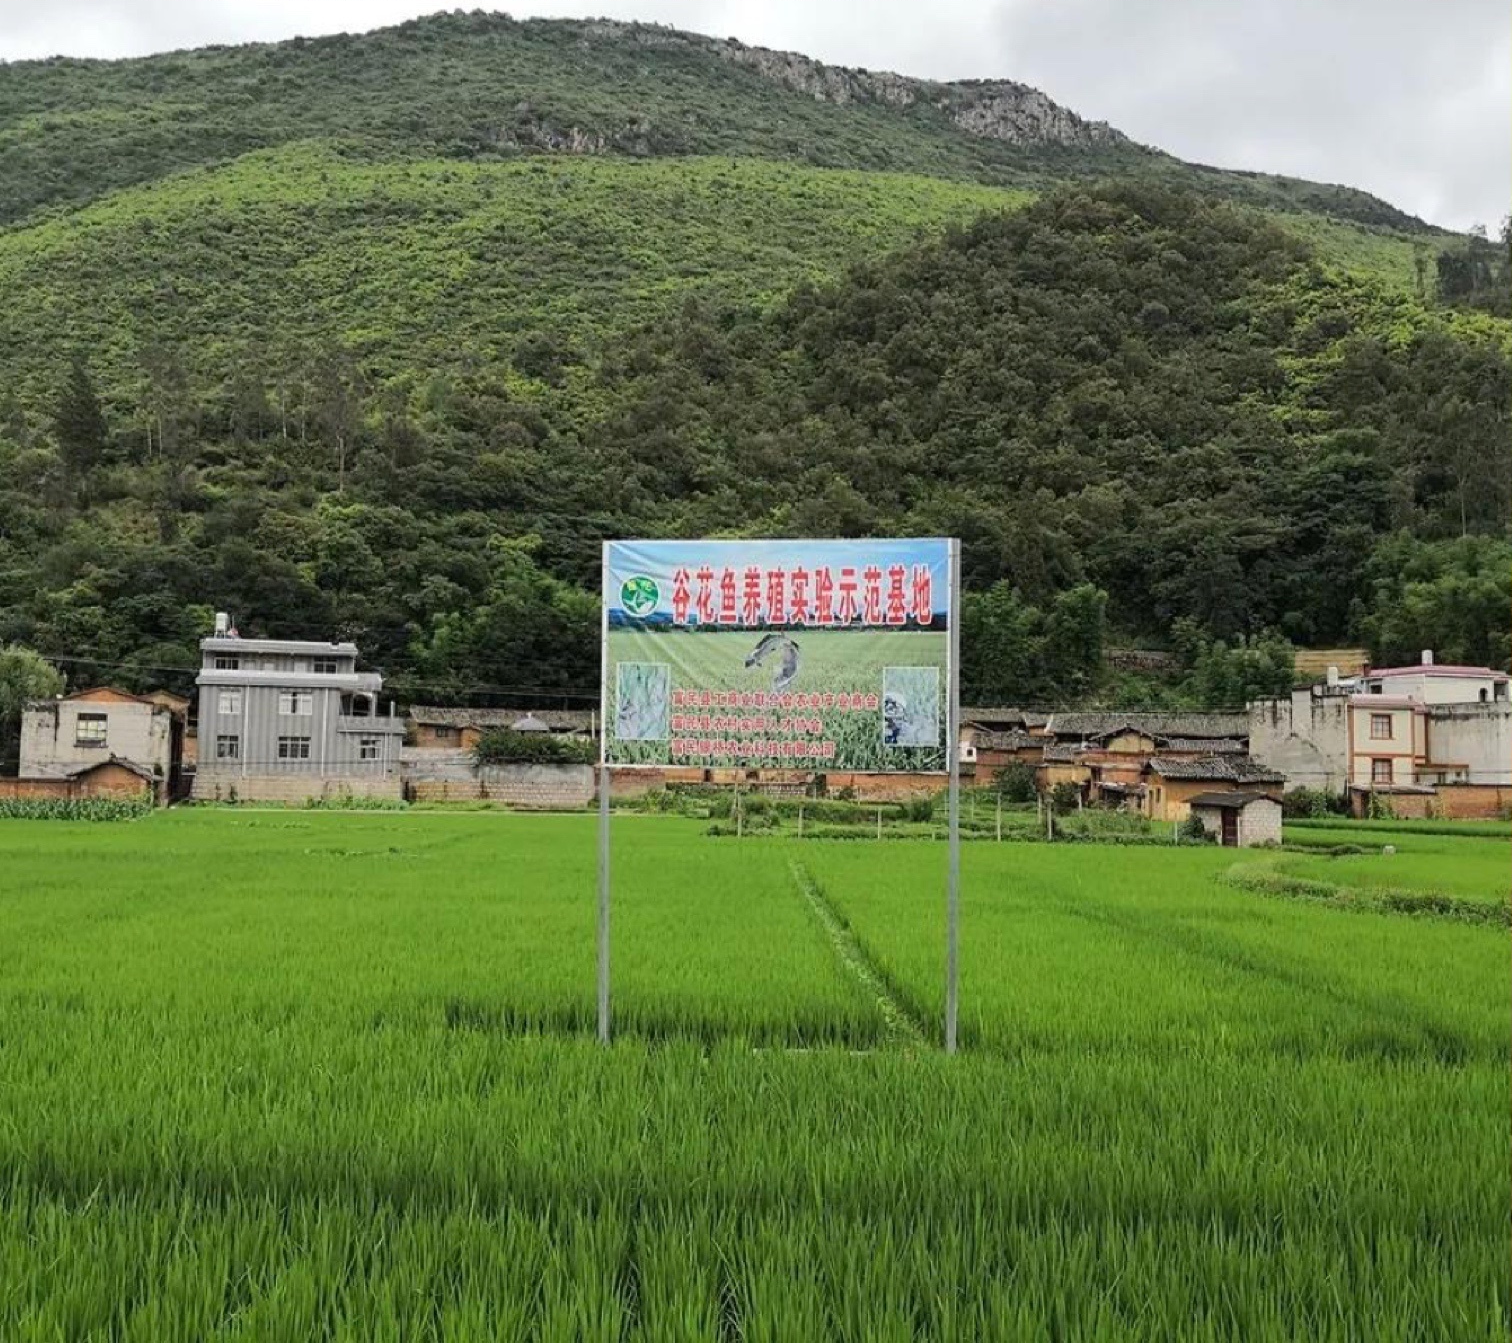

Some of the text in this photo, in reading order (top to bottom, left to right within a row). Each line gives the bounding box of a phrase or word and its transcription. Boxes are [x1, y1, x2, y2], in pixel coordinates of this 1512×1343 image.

[673, 563, 933, 625] 谷花鱼养殖实验示范基地
